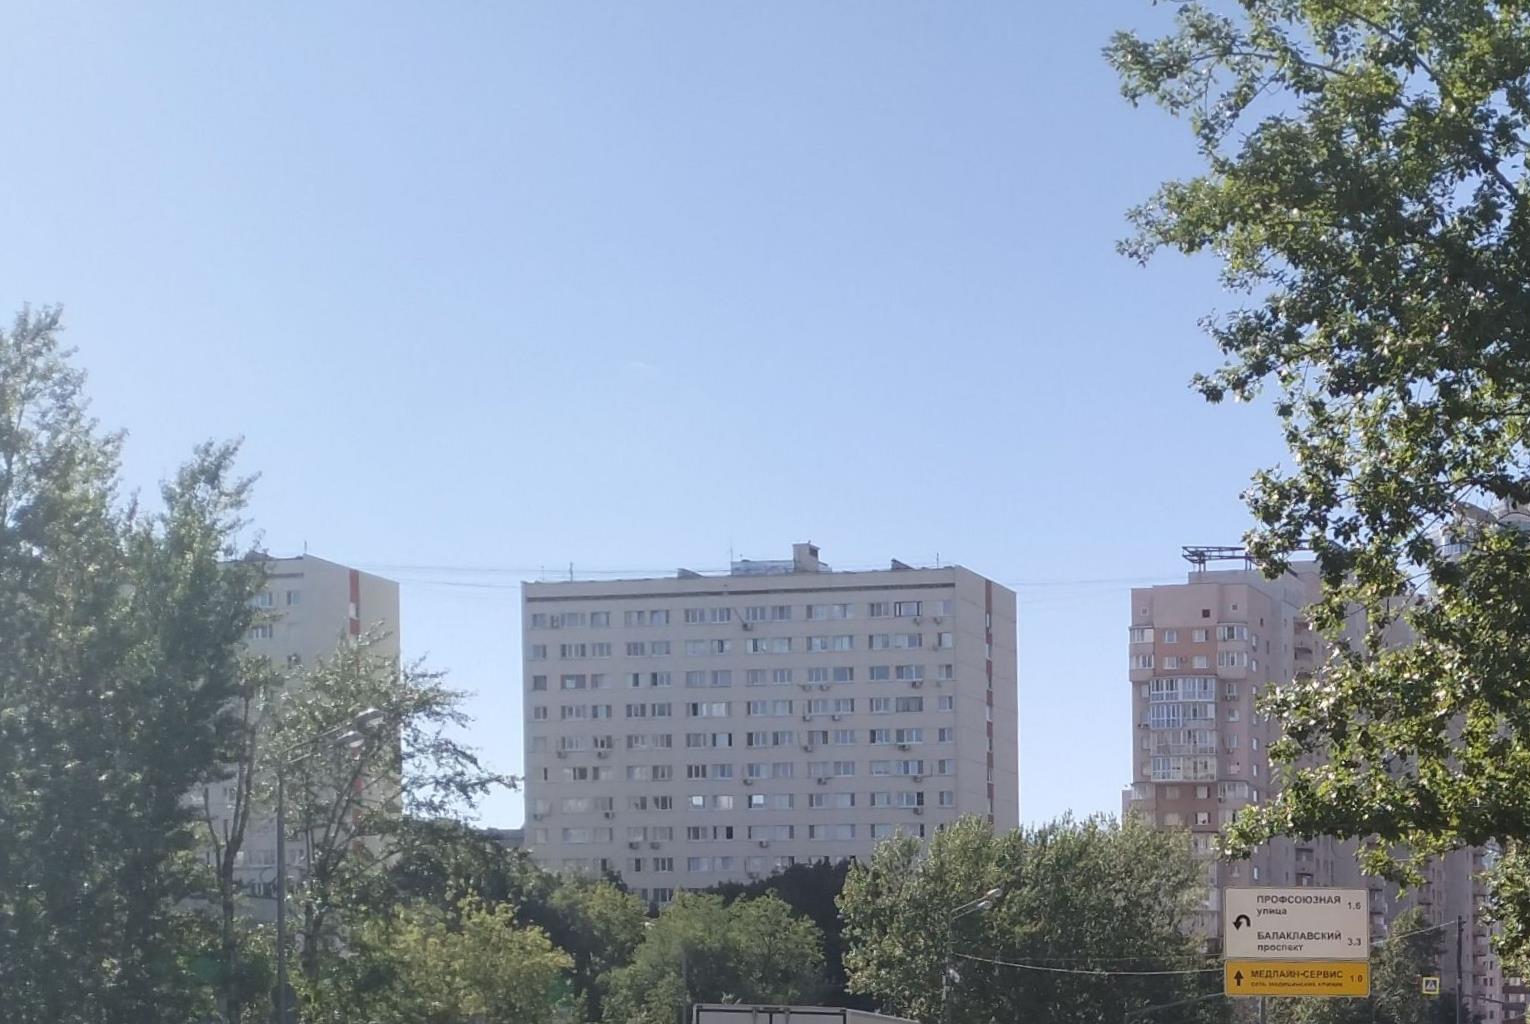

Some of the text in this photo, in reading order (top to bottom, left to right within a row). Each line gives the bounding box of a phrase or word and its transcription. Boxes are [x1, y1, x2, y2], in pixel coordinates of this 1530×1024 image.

[1257, 895, 1341, 904] ПРОФСОЮЗНАЯ
[1257, 908, 1287, 916] улица
[1257, 931, 1342, 940] БАЛАКЛАВСКИЙ
[1257, 944, 1304, 952] проспект
